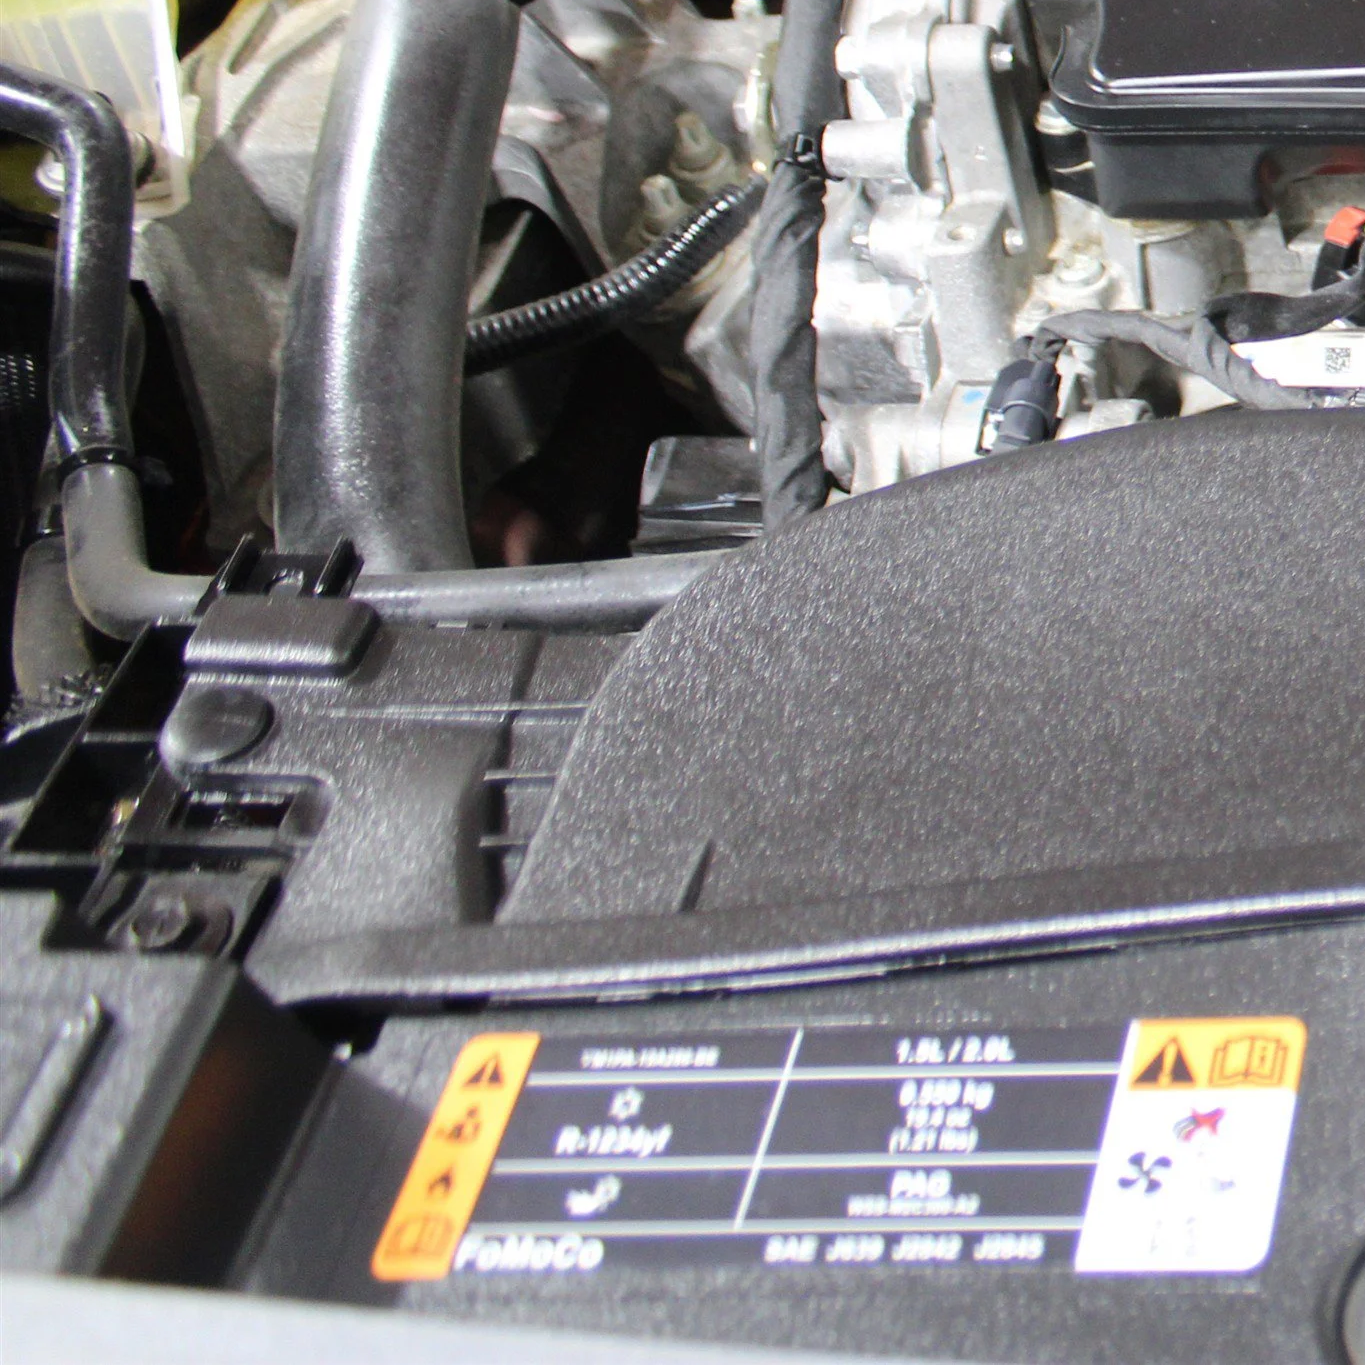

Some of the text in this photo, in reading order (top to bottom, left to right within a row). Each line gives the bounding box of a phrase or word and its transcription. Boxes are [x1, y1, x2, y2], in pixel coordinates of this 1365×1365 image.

[962, 1035, 1016, 1063] 2.0L
[962, 1078, 994, 1111] kg
[555, 1123, 674, 1158] R-1234yf
[890, 1169, 952, 1199] PAG
[453, 1233, 604, 1271] FoMoCo
[763, 1233, 819, 1263] SAE
